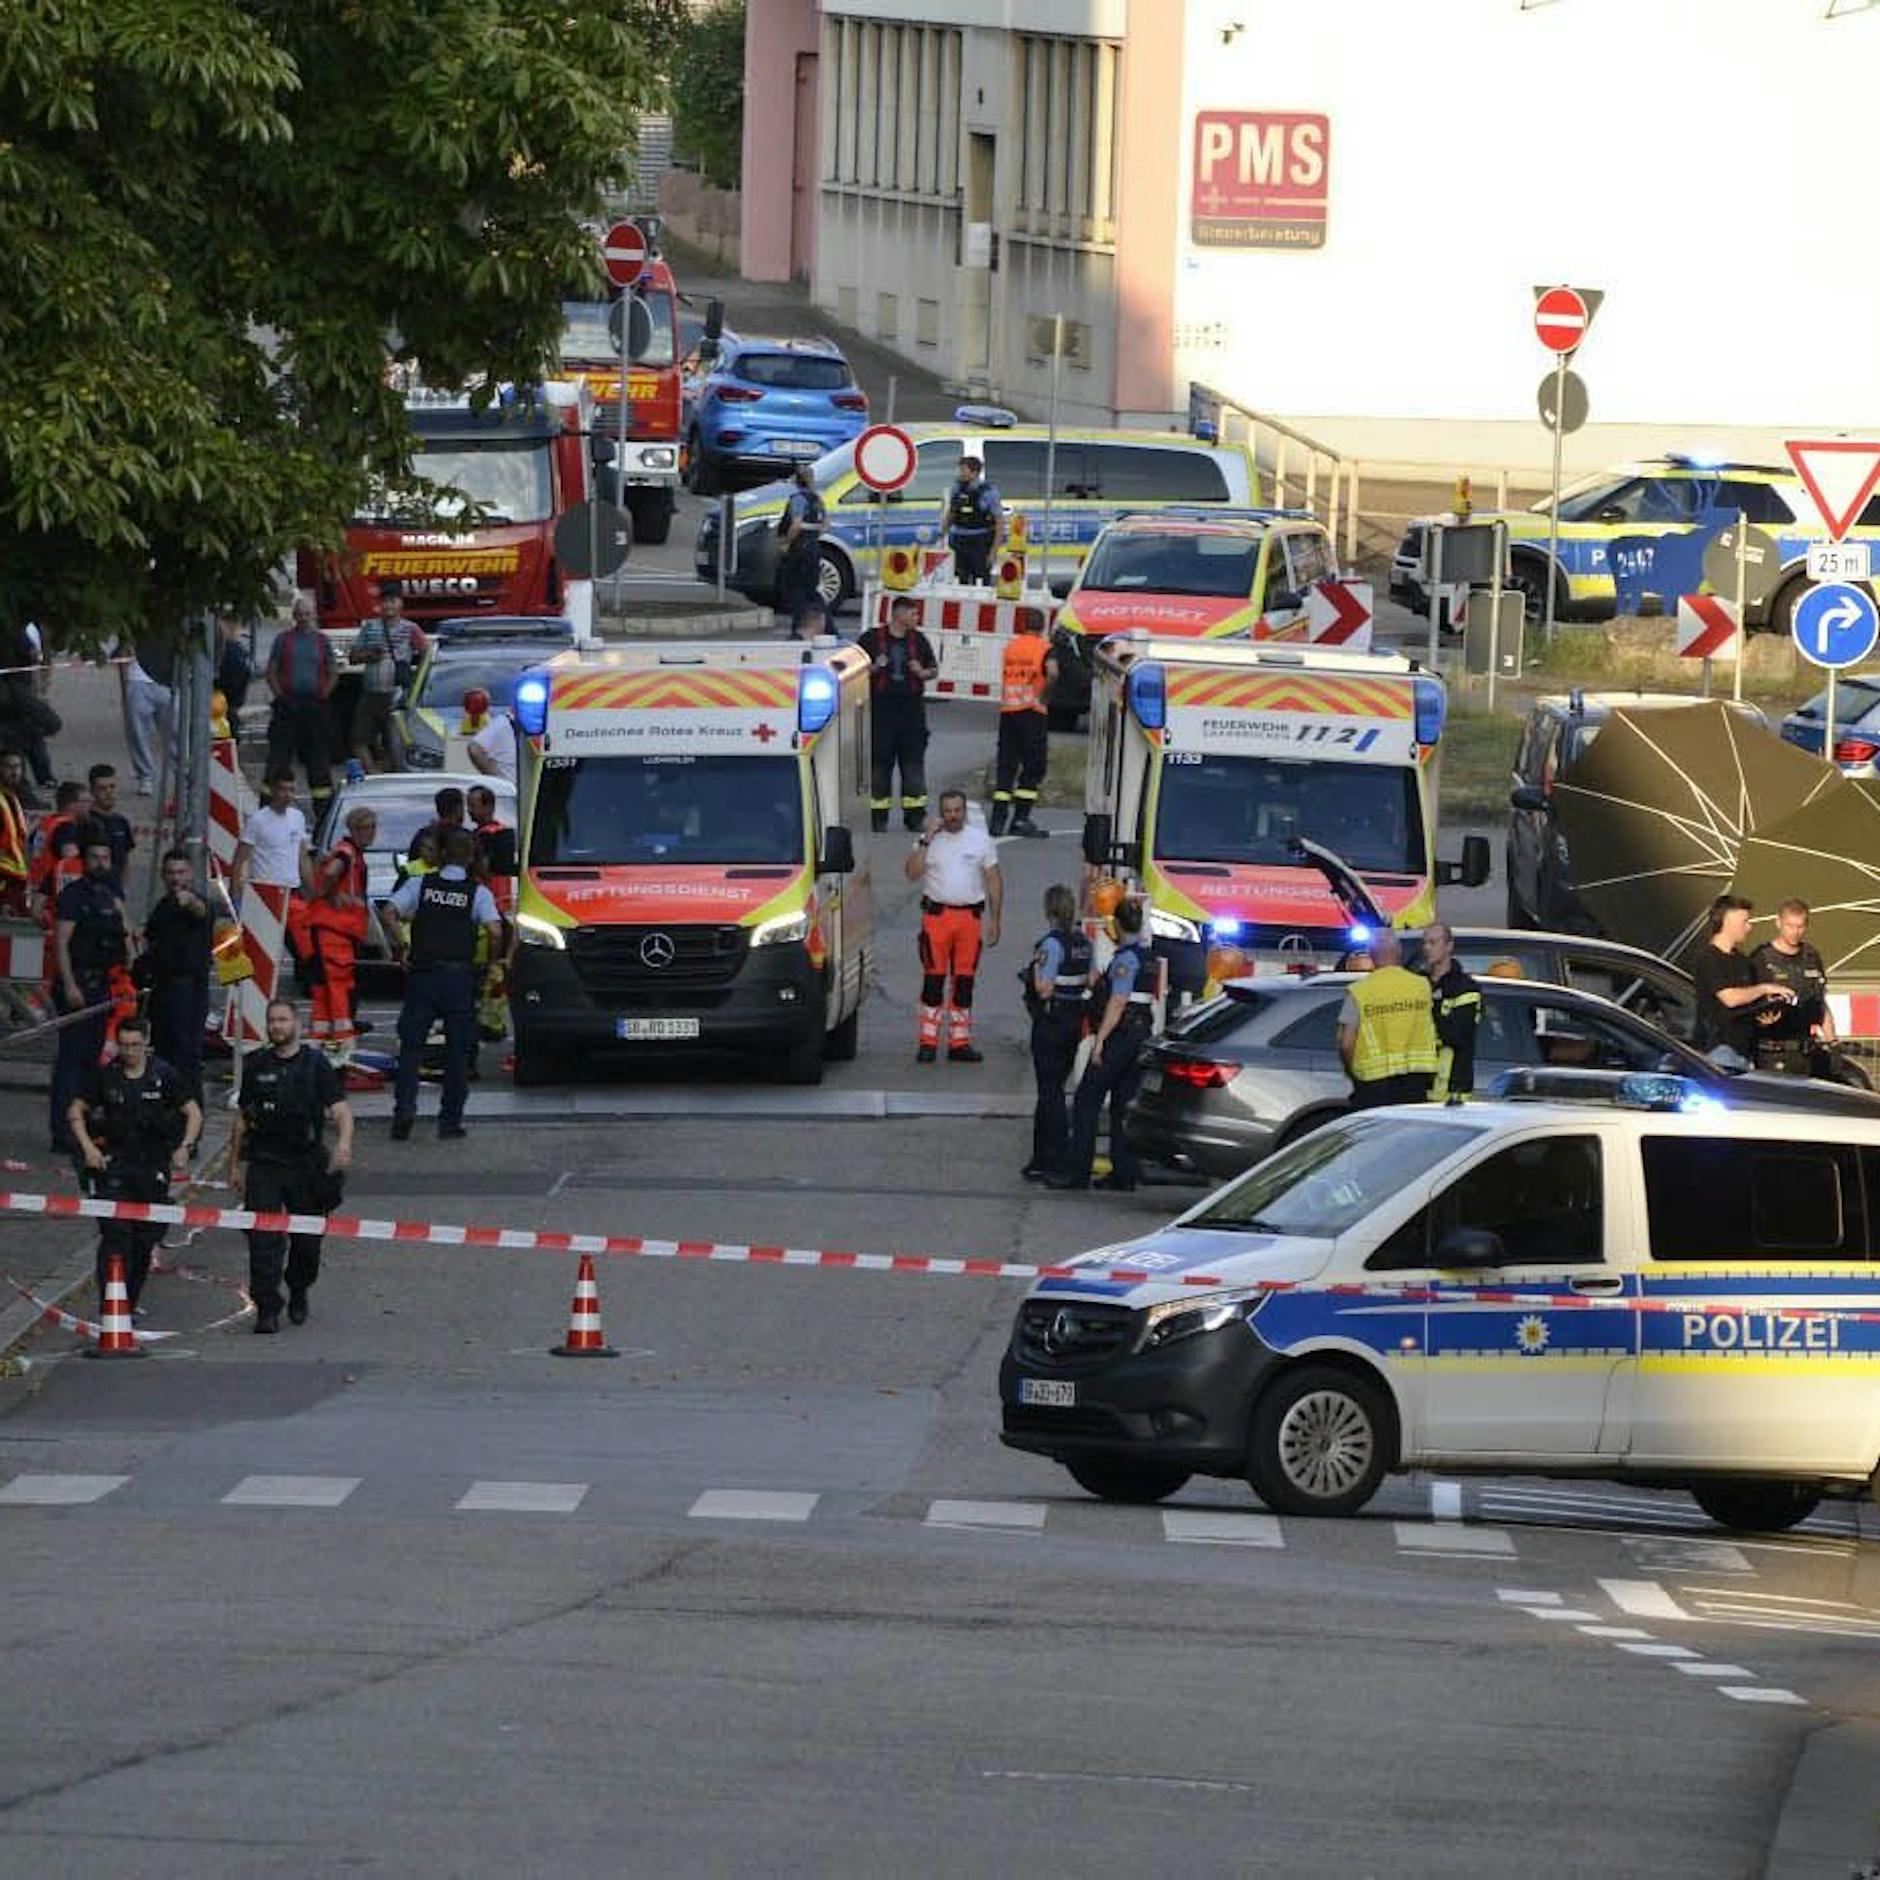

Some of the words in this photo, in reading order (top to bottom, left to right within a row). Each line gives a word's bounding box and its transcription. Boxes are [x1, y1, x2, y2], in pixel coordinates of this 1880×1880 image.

[1200, 123, 1323, 186] PMS
[361, 550, 519, 576] FEUERWEHR
[1819, 553, 1838, 573] 25
[1845, 556, 1859, 573] m
[401, 577, 478, 594] IVECO
[565, 727, 644, 739] Deutsches
[649, 727, 693, 737] Rotes
[700, 726, 744, 737] Kreuz
[1202, 719, 1289, 732] FEUERWEHR
[1296, 724, 1358, 744] 112
[425, 888, 468, 907] POLIZEI
[1682, 1311, 1839, 1348] POLIZEI
